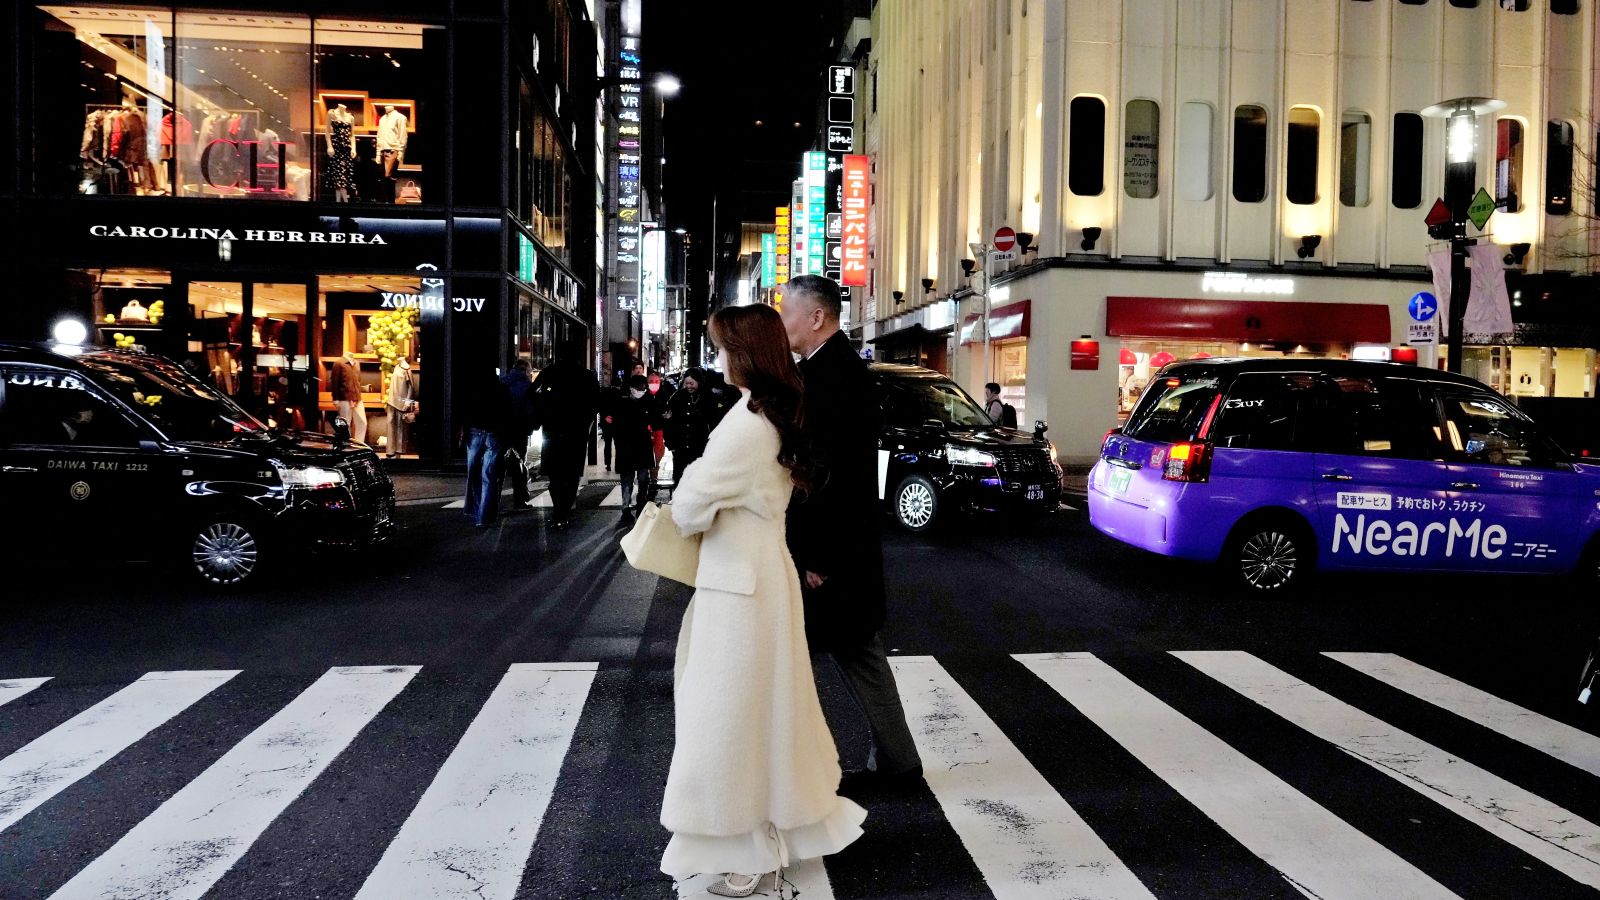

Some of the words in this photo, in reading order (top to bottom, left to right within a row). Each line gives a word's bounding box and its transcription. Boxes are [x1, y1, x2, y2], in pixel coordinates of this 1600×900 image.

[621, 96, 639, 107] VR
[201, 138, 296, 193] CH
[89, 225, 239, 241] CAROLINA
[244, 230, 388, 245] HERRERA
[47, 460, 87, 470] DAIWA
[92, 461, 119, 471] TAXI
[125, 463, 148, 471] 1212
[1499, 472, 1529, 480] Hinomaru
[1341, 495, 1387, 508] 配車サービス
[1331, 513, 1508, 560] NearMe
[1510, 542, 1557, 559] ニアミー
